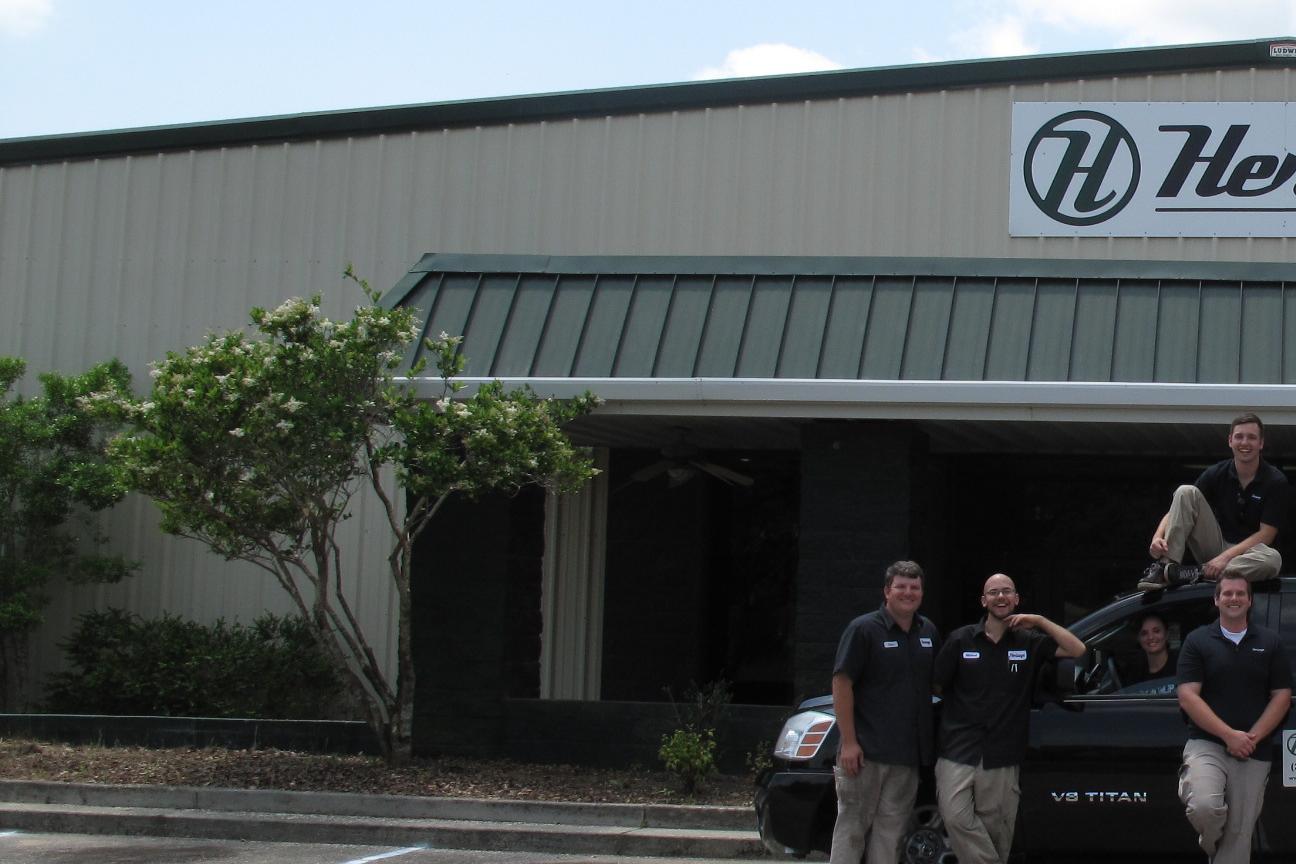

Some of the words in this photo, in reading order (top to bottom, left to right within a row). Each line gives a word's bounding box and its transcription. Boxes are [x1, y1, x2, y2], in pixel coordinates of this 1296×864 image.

[1036, 120, 1129, 217] H
[1051, 791, 1079, 802] V8
[1085, 791, 1147, 803] TITAN
